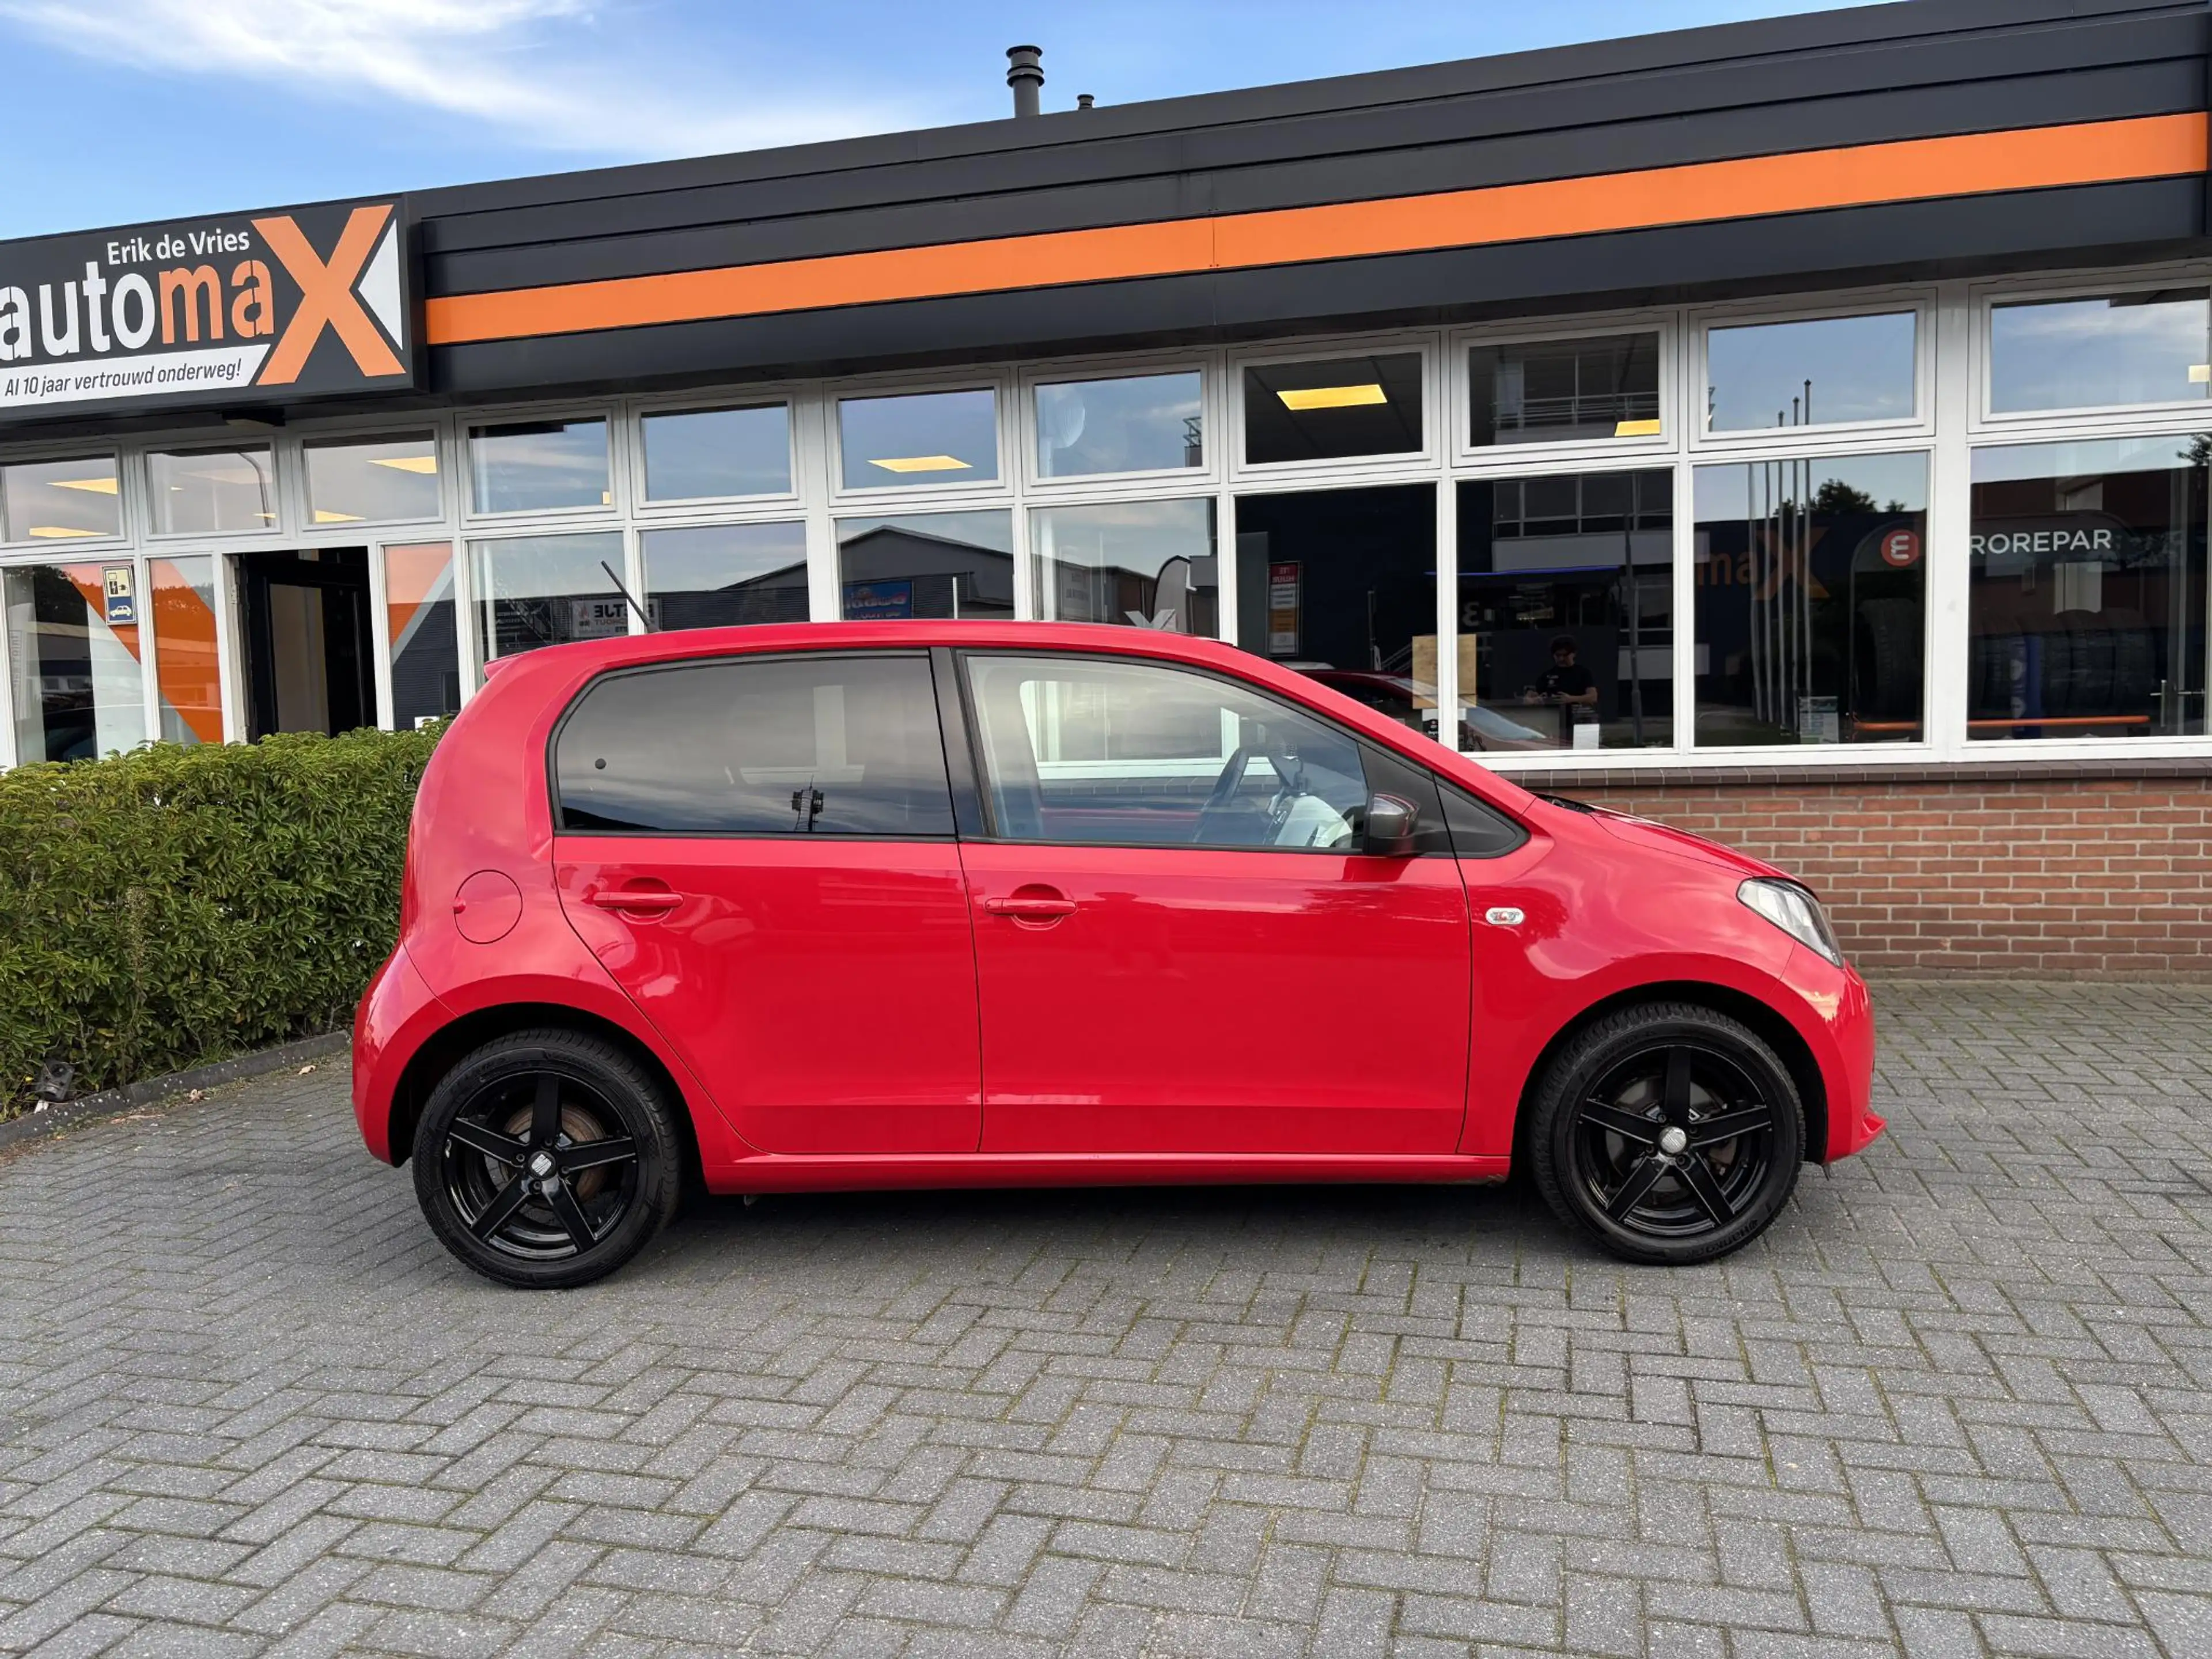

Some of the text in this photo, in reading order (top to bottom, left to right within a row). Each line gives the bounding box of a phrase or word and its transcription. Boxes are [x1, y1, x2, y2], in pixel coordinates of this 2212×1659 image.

[105, 228, 250, 265] Erik de Vries
[5, 358, 242, 397] Al 10 jaar vertrouwd onderweg!
[1969, 529, 2113, 555] ROREPAR
